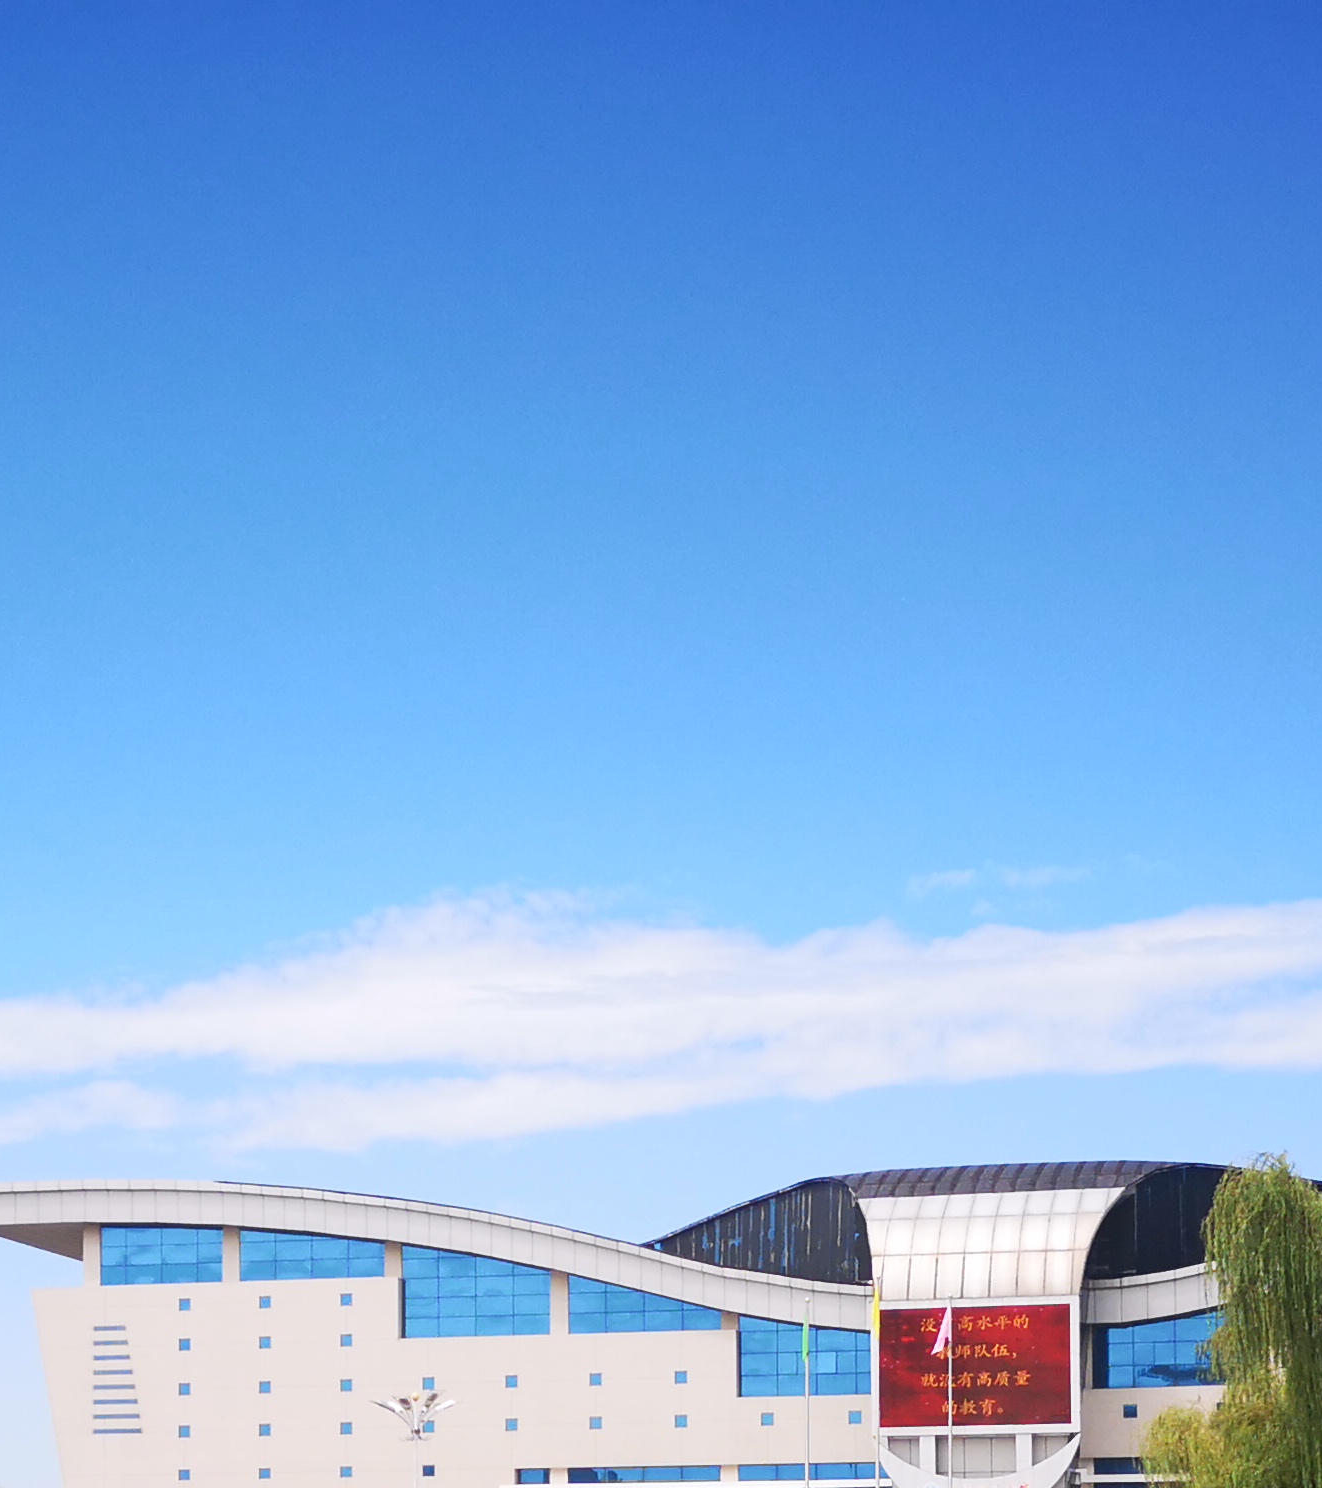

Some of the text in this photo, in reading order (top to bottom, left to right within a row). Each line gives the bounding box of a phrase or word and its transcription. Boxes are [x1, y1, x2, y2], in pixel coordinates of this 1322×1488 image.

[920, 1313, 1030, 1333] 没高水平的
